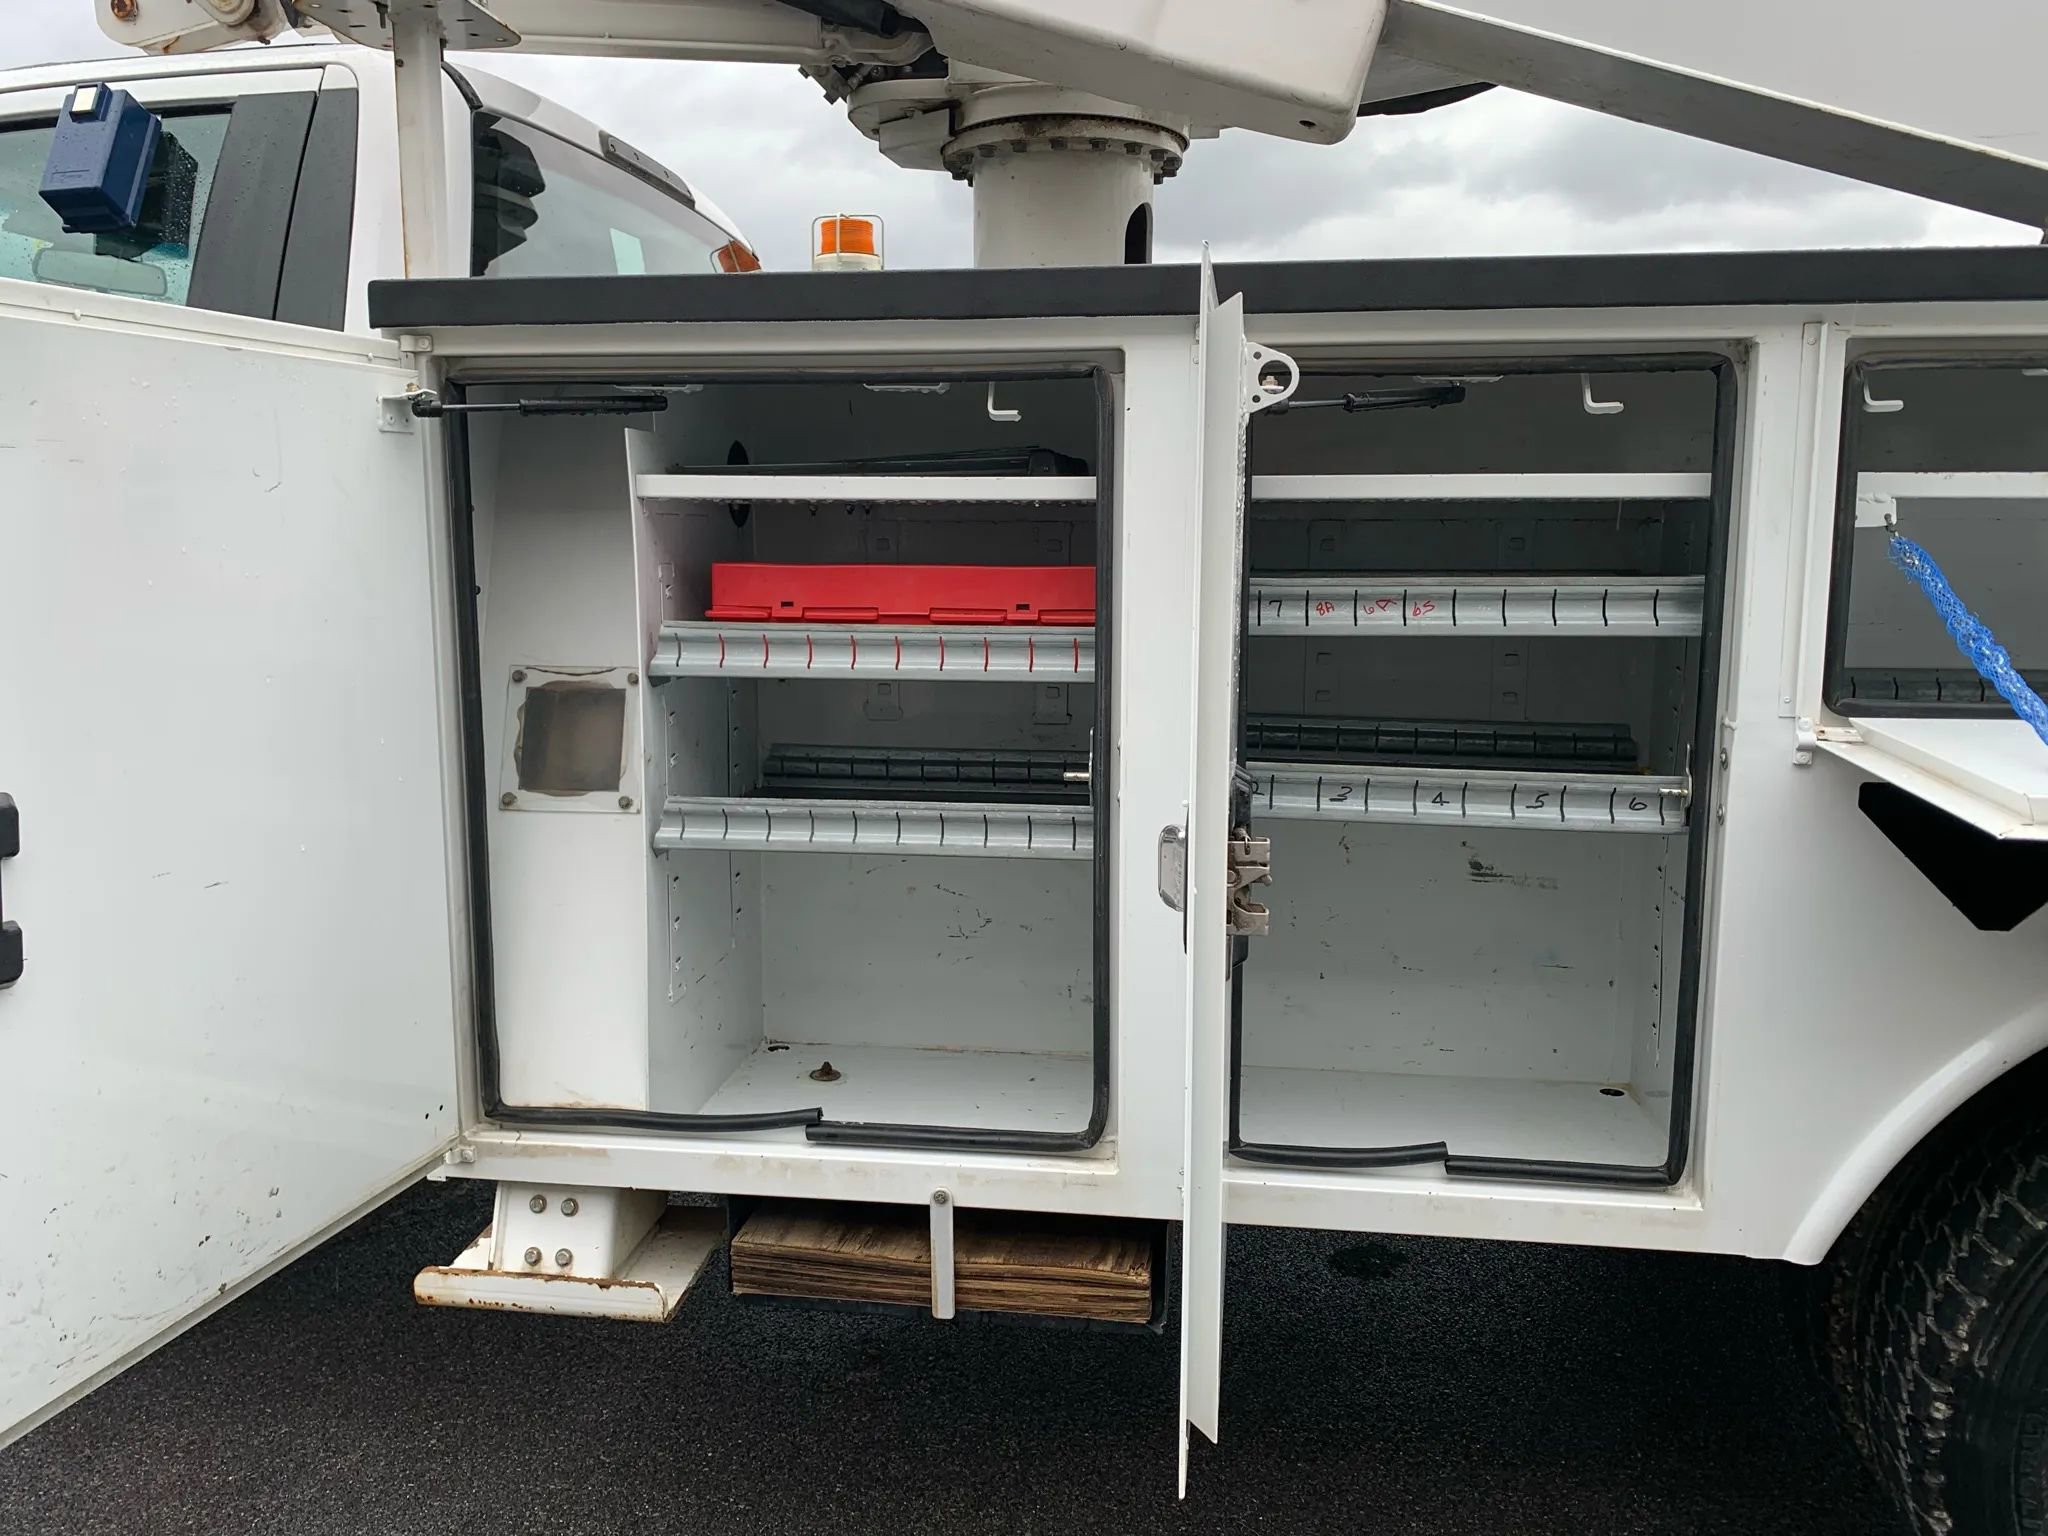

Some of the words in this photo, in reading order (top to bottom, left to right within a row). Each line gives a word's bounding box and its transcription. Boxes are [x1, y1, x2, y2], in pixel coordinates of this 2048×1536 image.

[1269, 600, 1282, 617] 7
[1329, 786, 1353, 802] 3
[1431, 791, 1450, 806] 4
[1526, 792, 1549, 809] 5
[1629, 796, 1648, 811] 6
